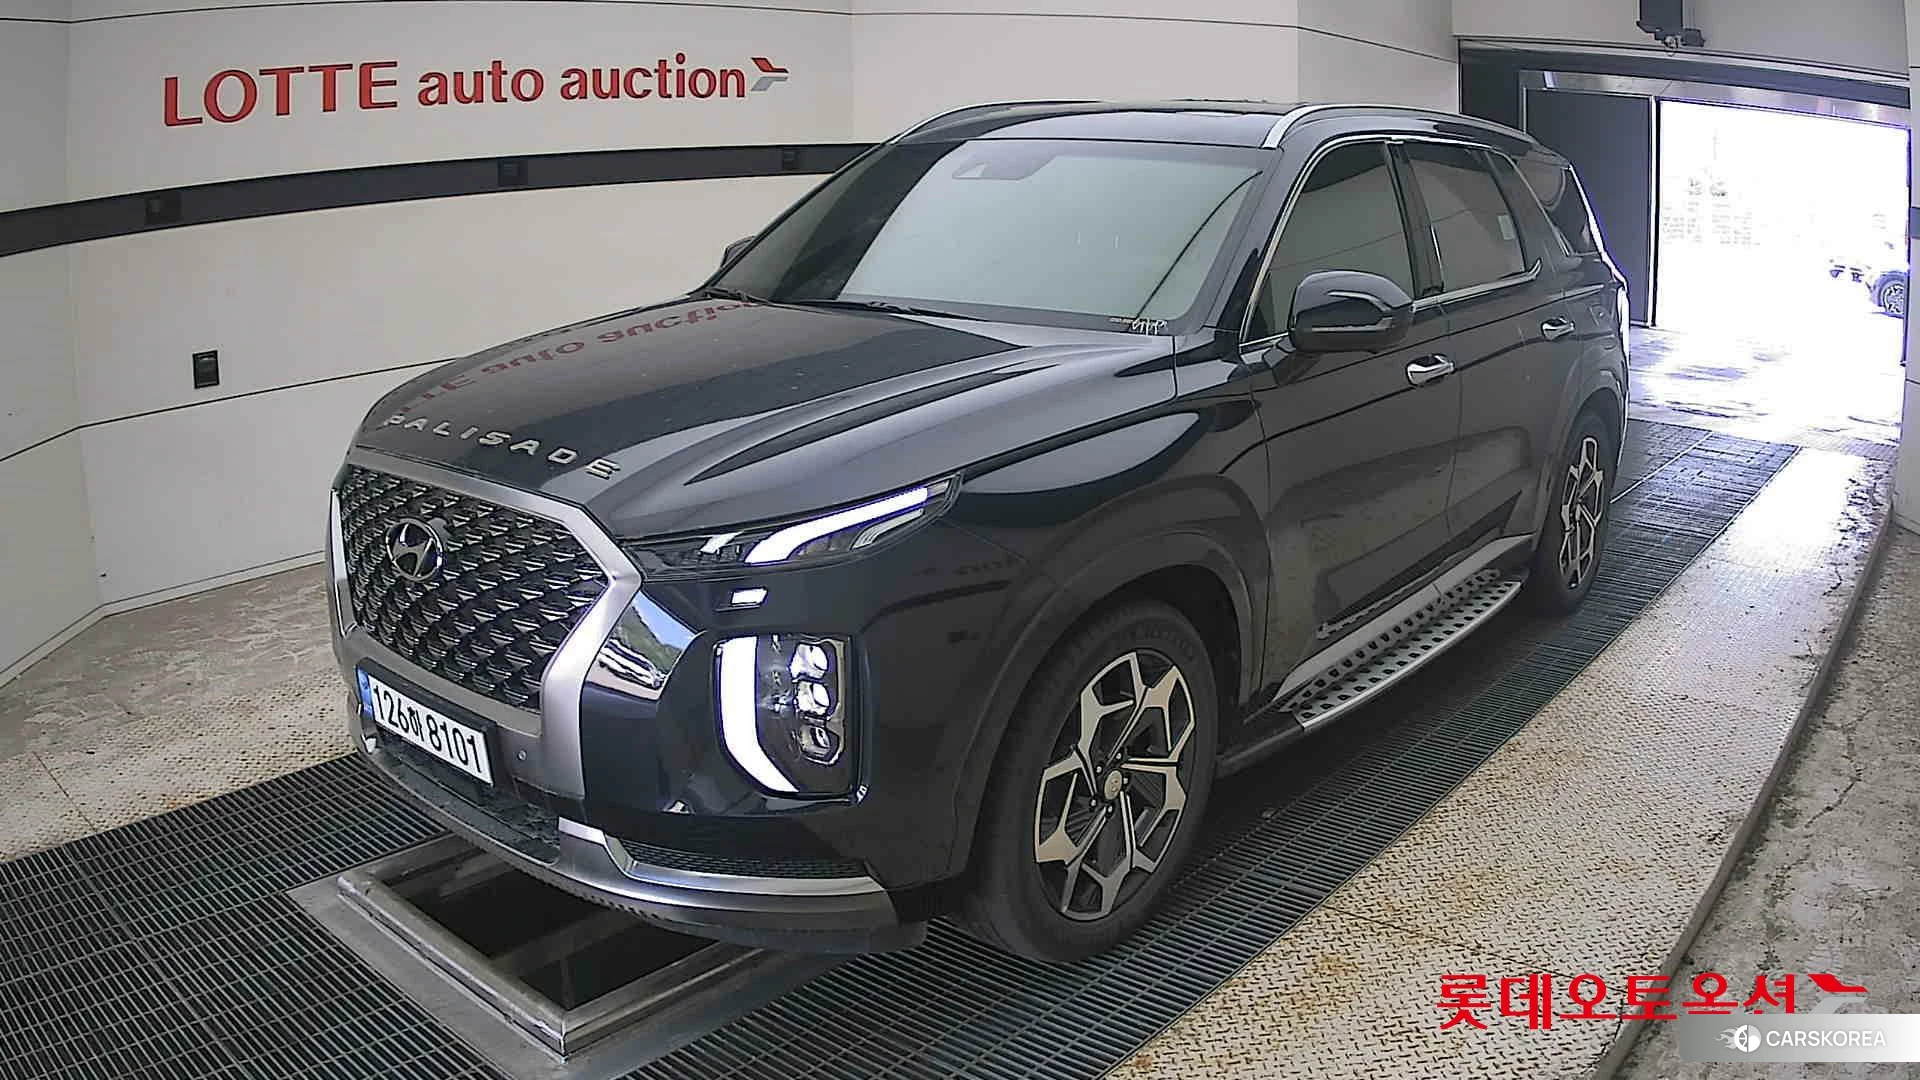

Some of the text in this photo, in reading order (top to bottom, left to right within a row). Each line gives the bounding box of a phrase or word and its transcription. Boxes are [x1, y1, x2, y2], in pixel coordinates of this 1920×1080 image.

[163, 53, 747, 127] LOTTE auto auction
[384, 414, 622, 480] PALISADE
[426, 714, 482, 773] 8101
